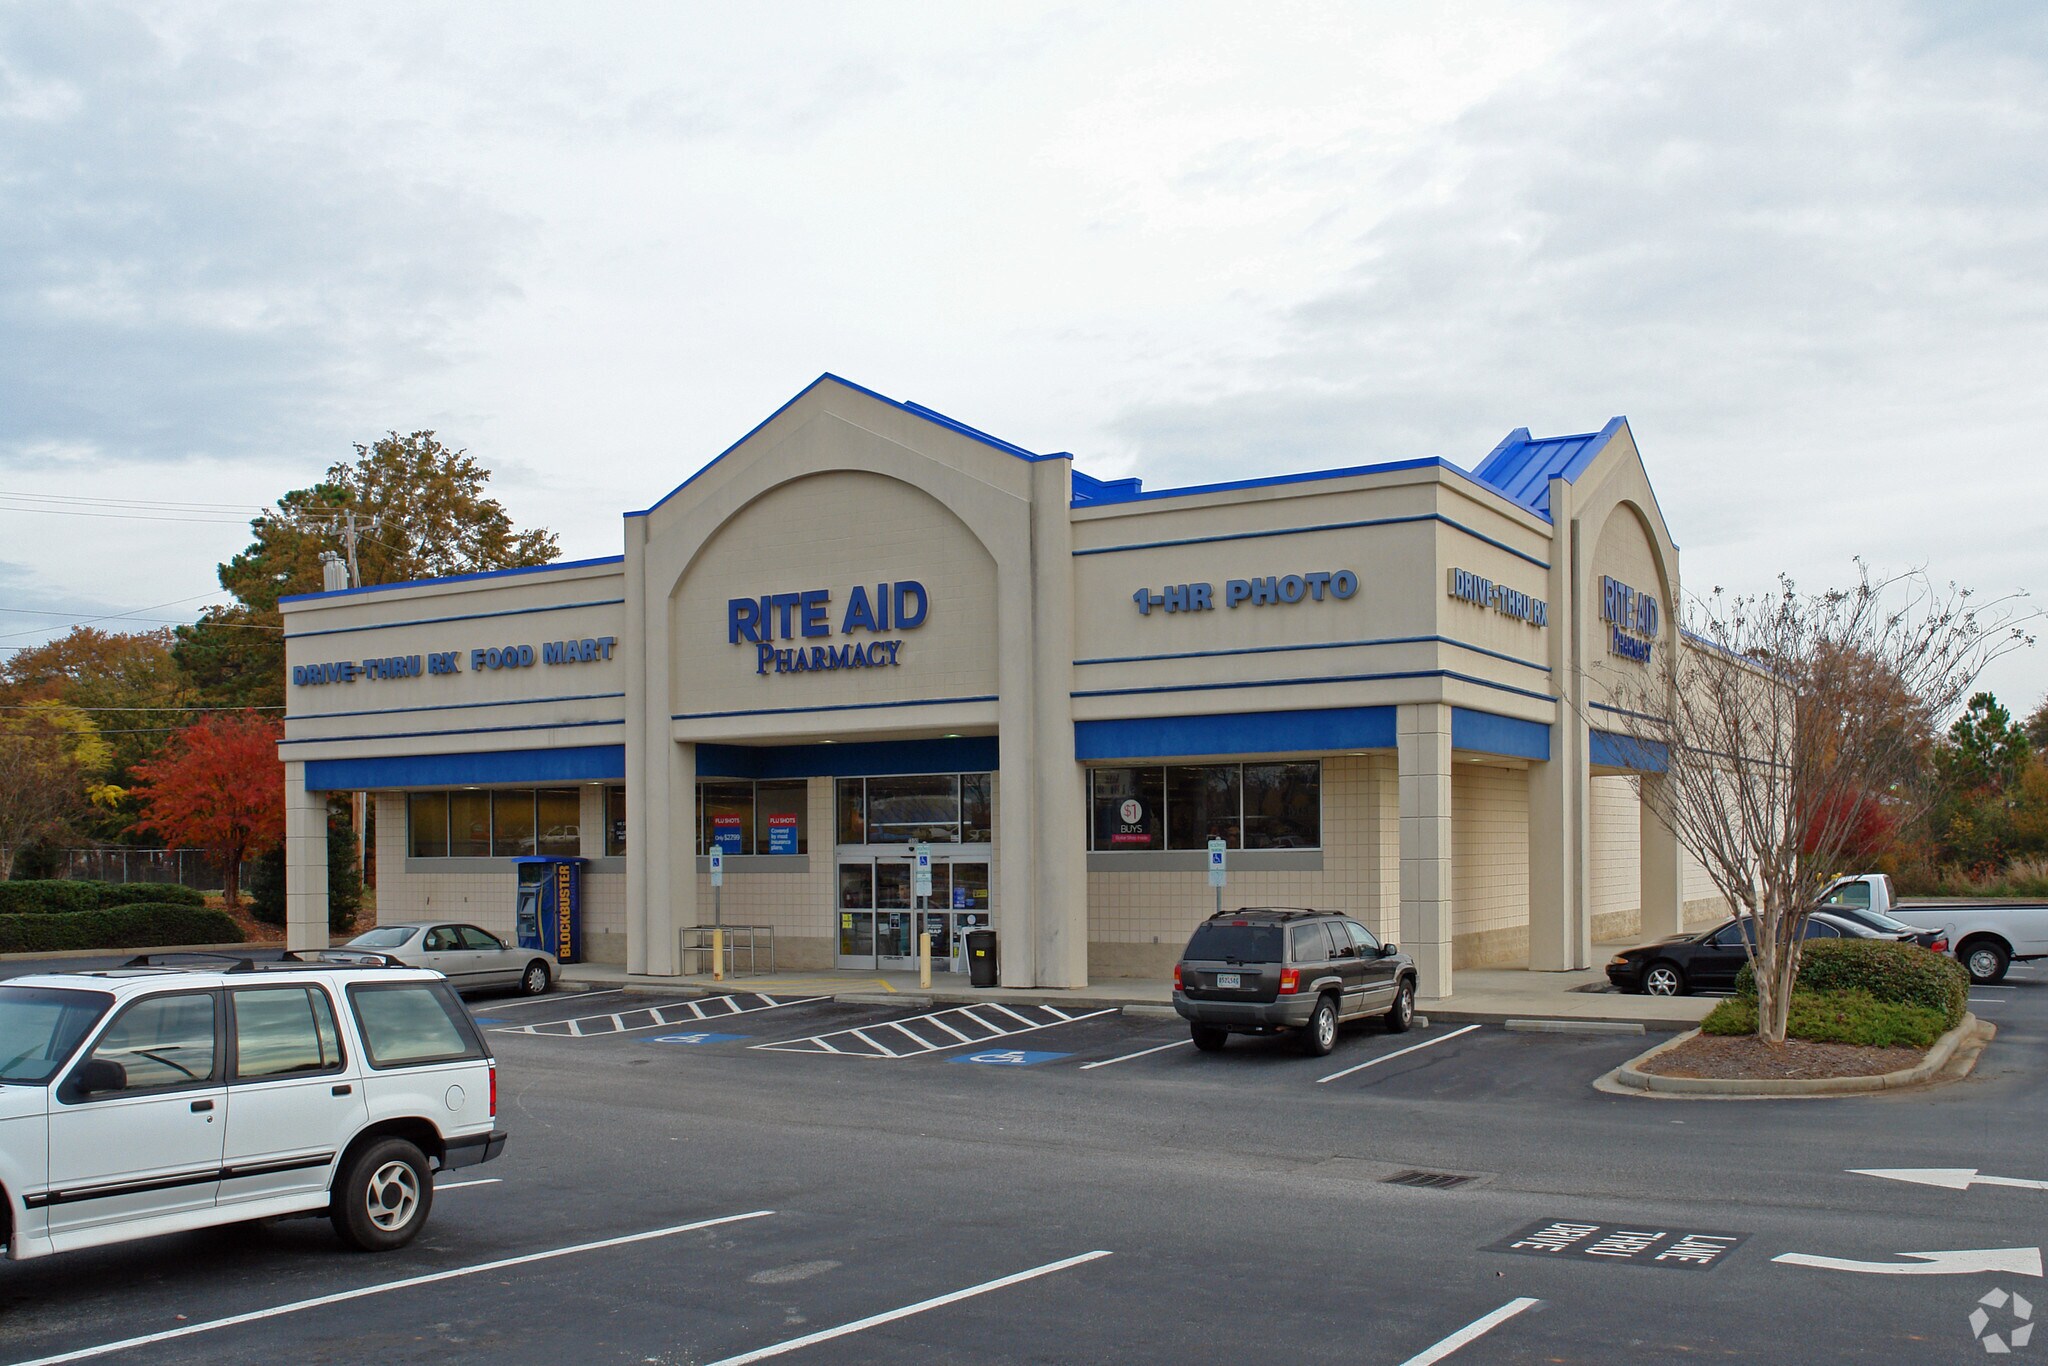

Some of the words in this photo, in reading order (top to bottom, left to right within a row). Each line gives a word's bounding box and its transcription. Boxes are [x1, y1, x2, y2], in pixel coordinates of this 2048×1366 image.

[728, 589, 831, 644] RITE
[841, 580, 930, 634] AID
[1132, 582, 1215, 615] 1-HR
[1226, 569, 1360, 609] PHOTO
[1450, 567, 1530, 621] DRIVE-THRU
[1533, 597, 1549, 628] RX
[1600, 575, 1635, 629] RITE
[1636, 592, 1659, 638] AID
[293, 655, 423, 686] DRIVE-THRU
[428, 651, 461, 674] RX
[471, 644, 537, 670] FOOD
[542, 636, 617, 664] MART
[756, 639, 902, 675] PHARMACY
[1120, 825, 1143, 833] BUYS
[1124, 804, 1137, 820] $1
[559, 865, 571, 958] BLOCKBUSTER
[1510, 1222, 1600, 1252] DRIVE
[1585, 1231, 1667, 1257] THRU
[1655, 1234, 1737, 1265] LANE
